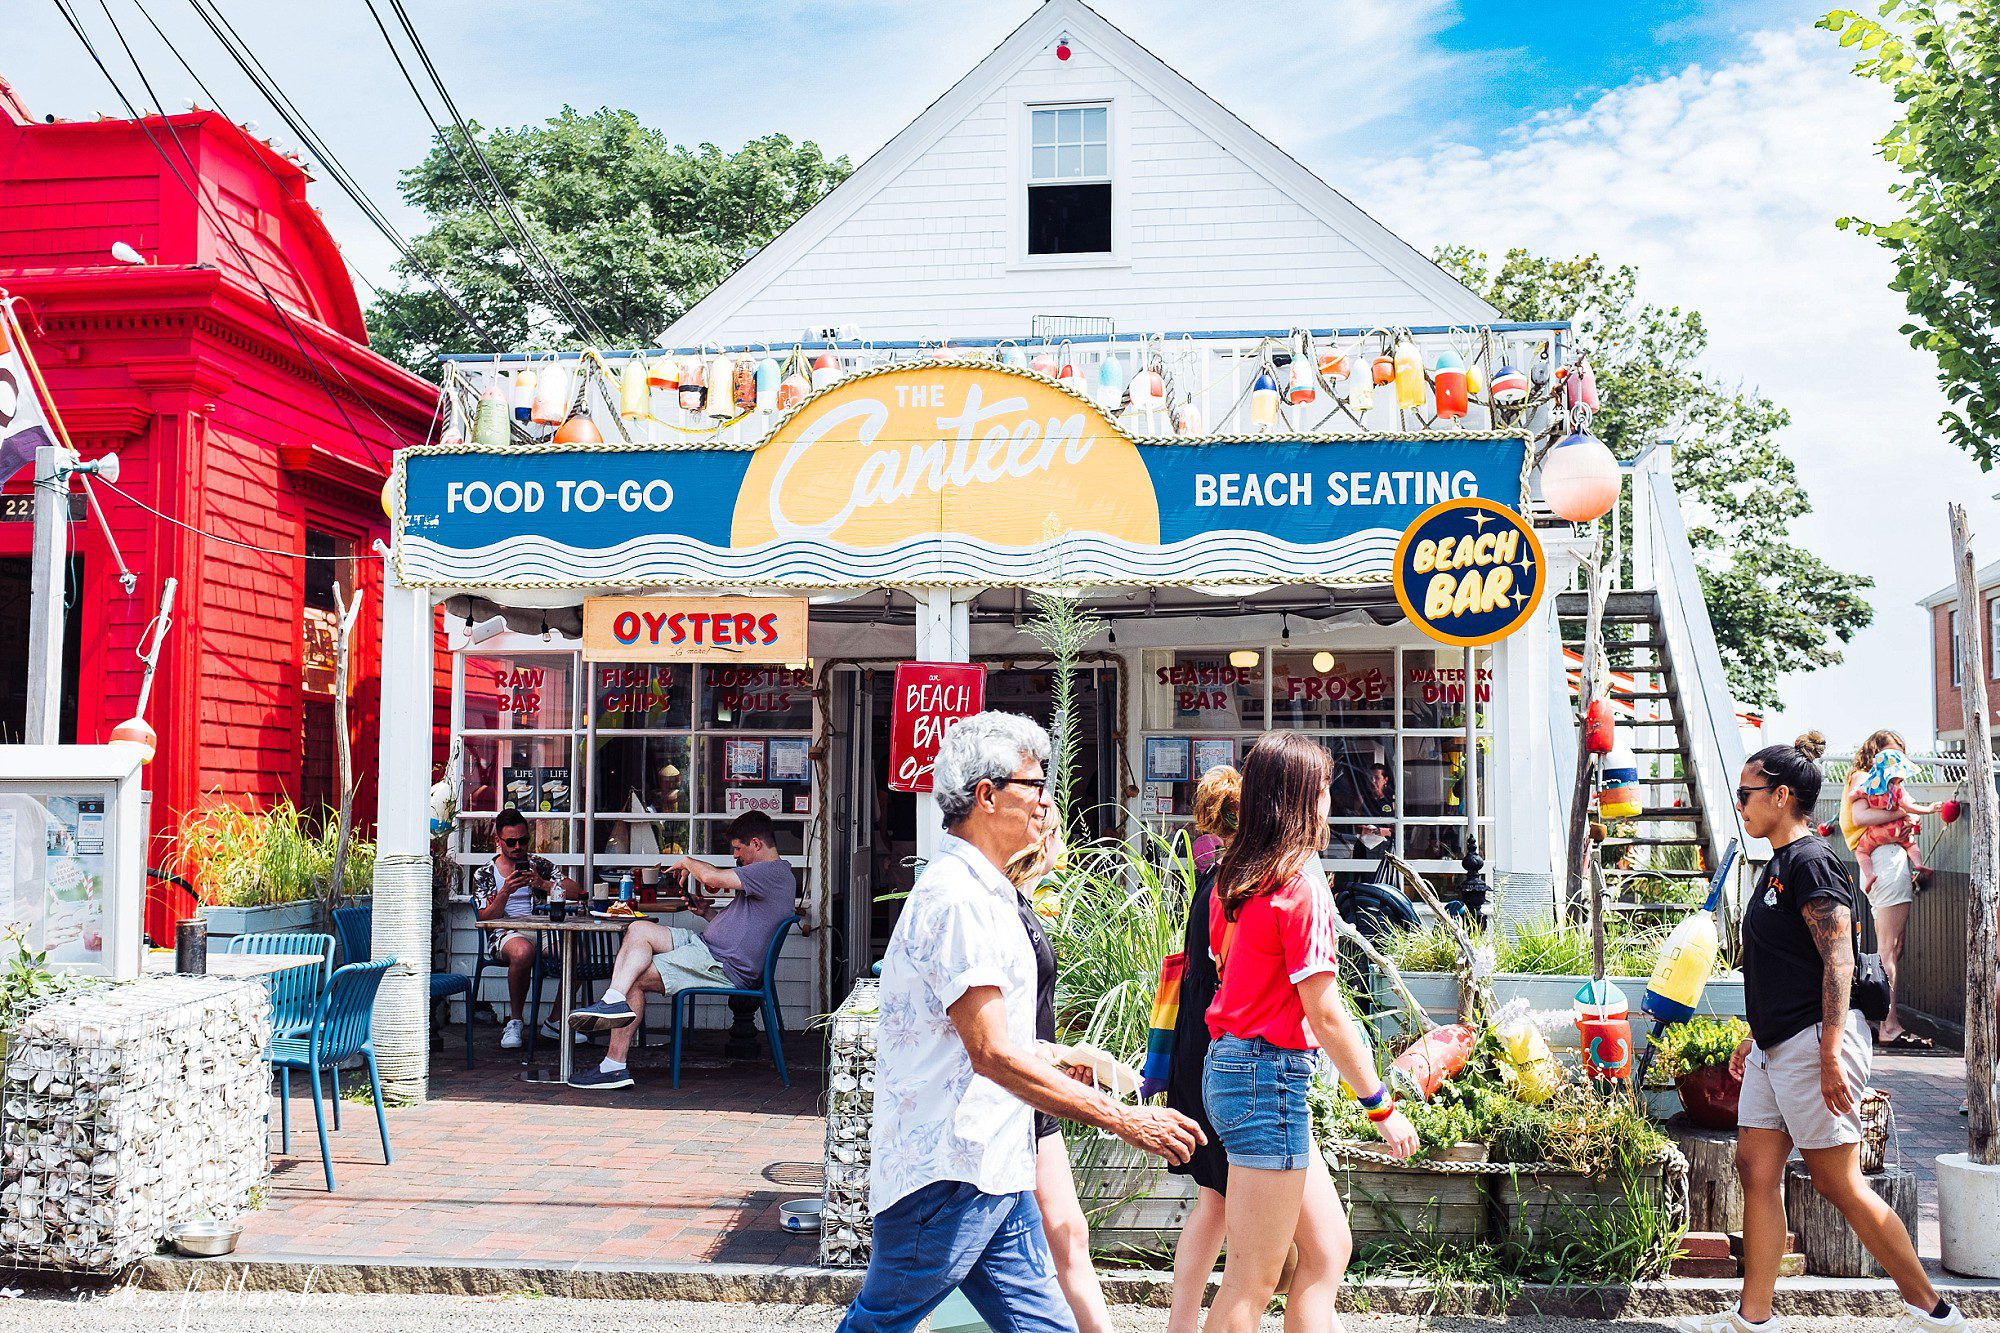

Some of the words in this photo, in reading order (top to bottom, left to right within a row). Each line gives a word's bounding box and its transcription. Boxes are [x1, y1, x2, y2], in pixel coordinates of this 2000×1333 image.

[895, 385, 944, 407] THE
[770, 383, 1096, 537] Canteen
[447, 481, 545, 513] FOOD
[556, 479, 674, 513] TO-GO
[1195, 472, 1312, 506] BEACH
[1327, 470, 1478, 506] SEATING
[1413, 529, 1520, 574] BEACH
[1424, 565, 1515, 620] BAR
[613, 611, 779, 645] OYSTERS
[494, 669, 545, 690] RAW
[601, 668, 650, 689] FISH
[657, 667, 674, 688] &
[706, 668, 808, 690] LOBSTER
[1156, 666, 1251, 686] SEASIDE
[1287, 667, 1383, 702] FROSÉ
[497, 693, 542, 714] BAR
[603, 693, 671, 714] CHIPS
[722, 693, 792, 713] ROLLS
[906, 684, 970, 712] BEACH
[1180, 691, 1228, 711] BAR
[514, 769, 534, 778] LIFE
[550, 769, 569, 778] LIFE
